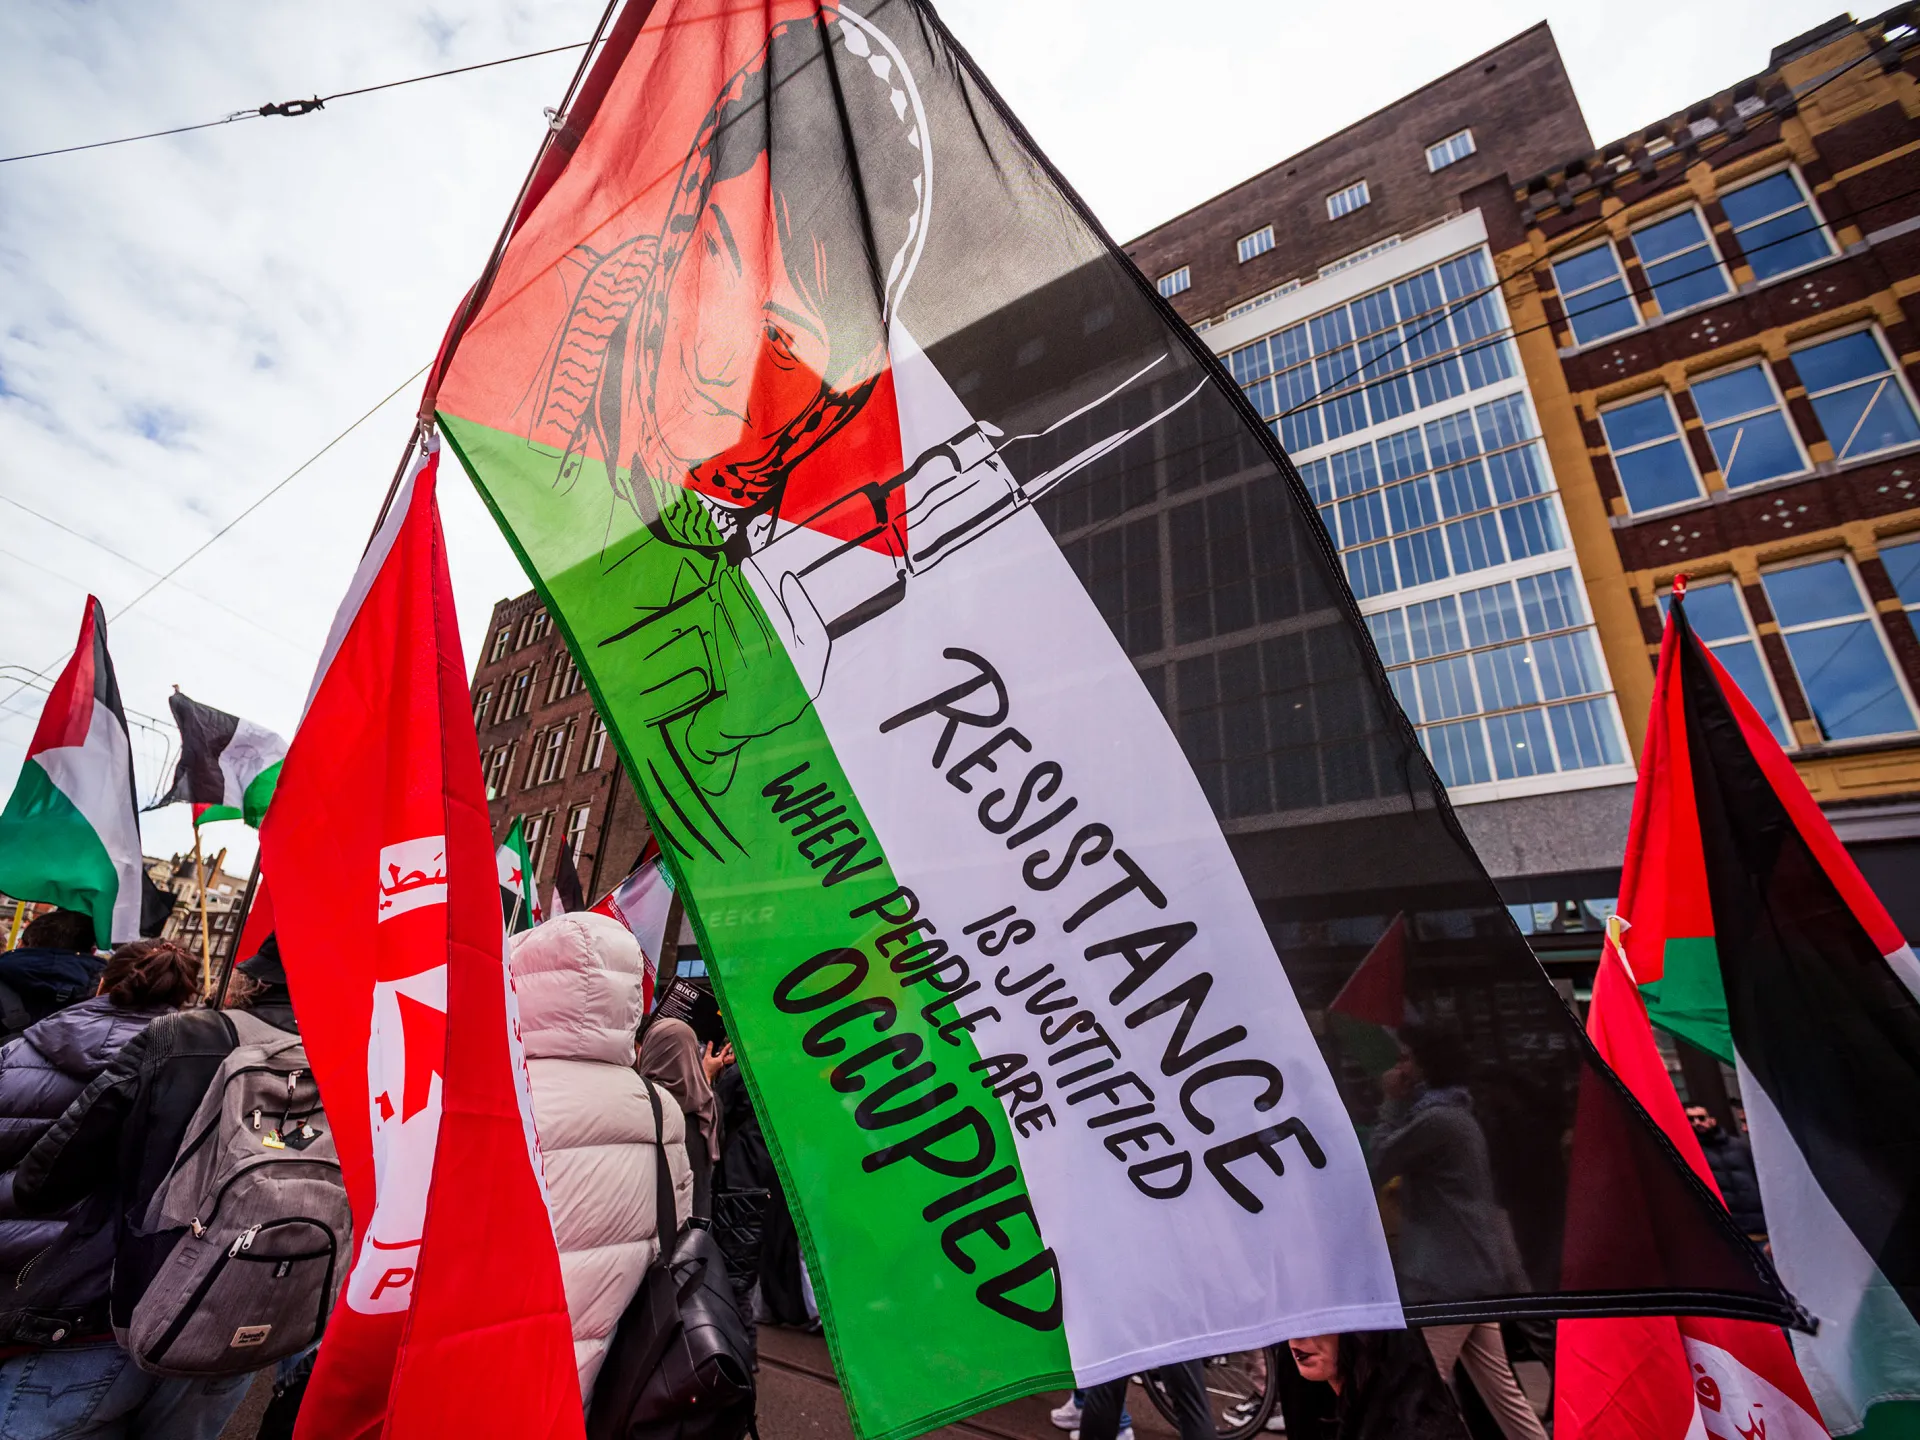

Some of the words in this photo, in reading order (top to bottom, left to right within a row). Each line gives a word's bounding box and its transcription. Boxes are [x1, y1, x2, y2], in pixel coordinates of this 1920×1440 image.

[762, 761, 883, 887] WHEN
[849, 886, 1001, 1046] PEOPLE
[969, 1054, 1056, 1138] ARE
[880, 648, 1327, 1213] RESISTANCE
[963, 906, 1036, 957] IS
[995, 964, 1193, 1199] JUSTIFIED
[773, 948, 1063, 1331] OCCUPIED
